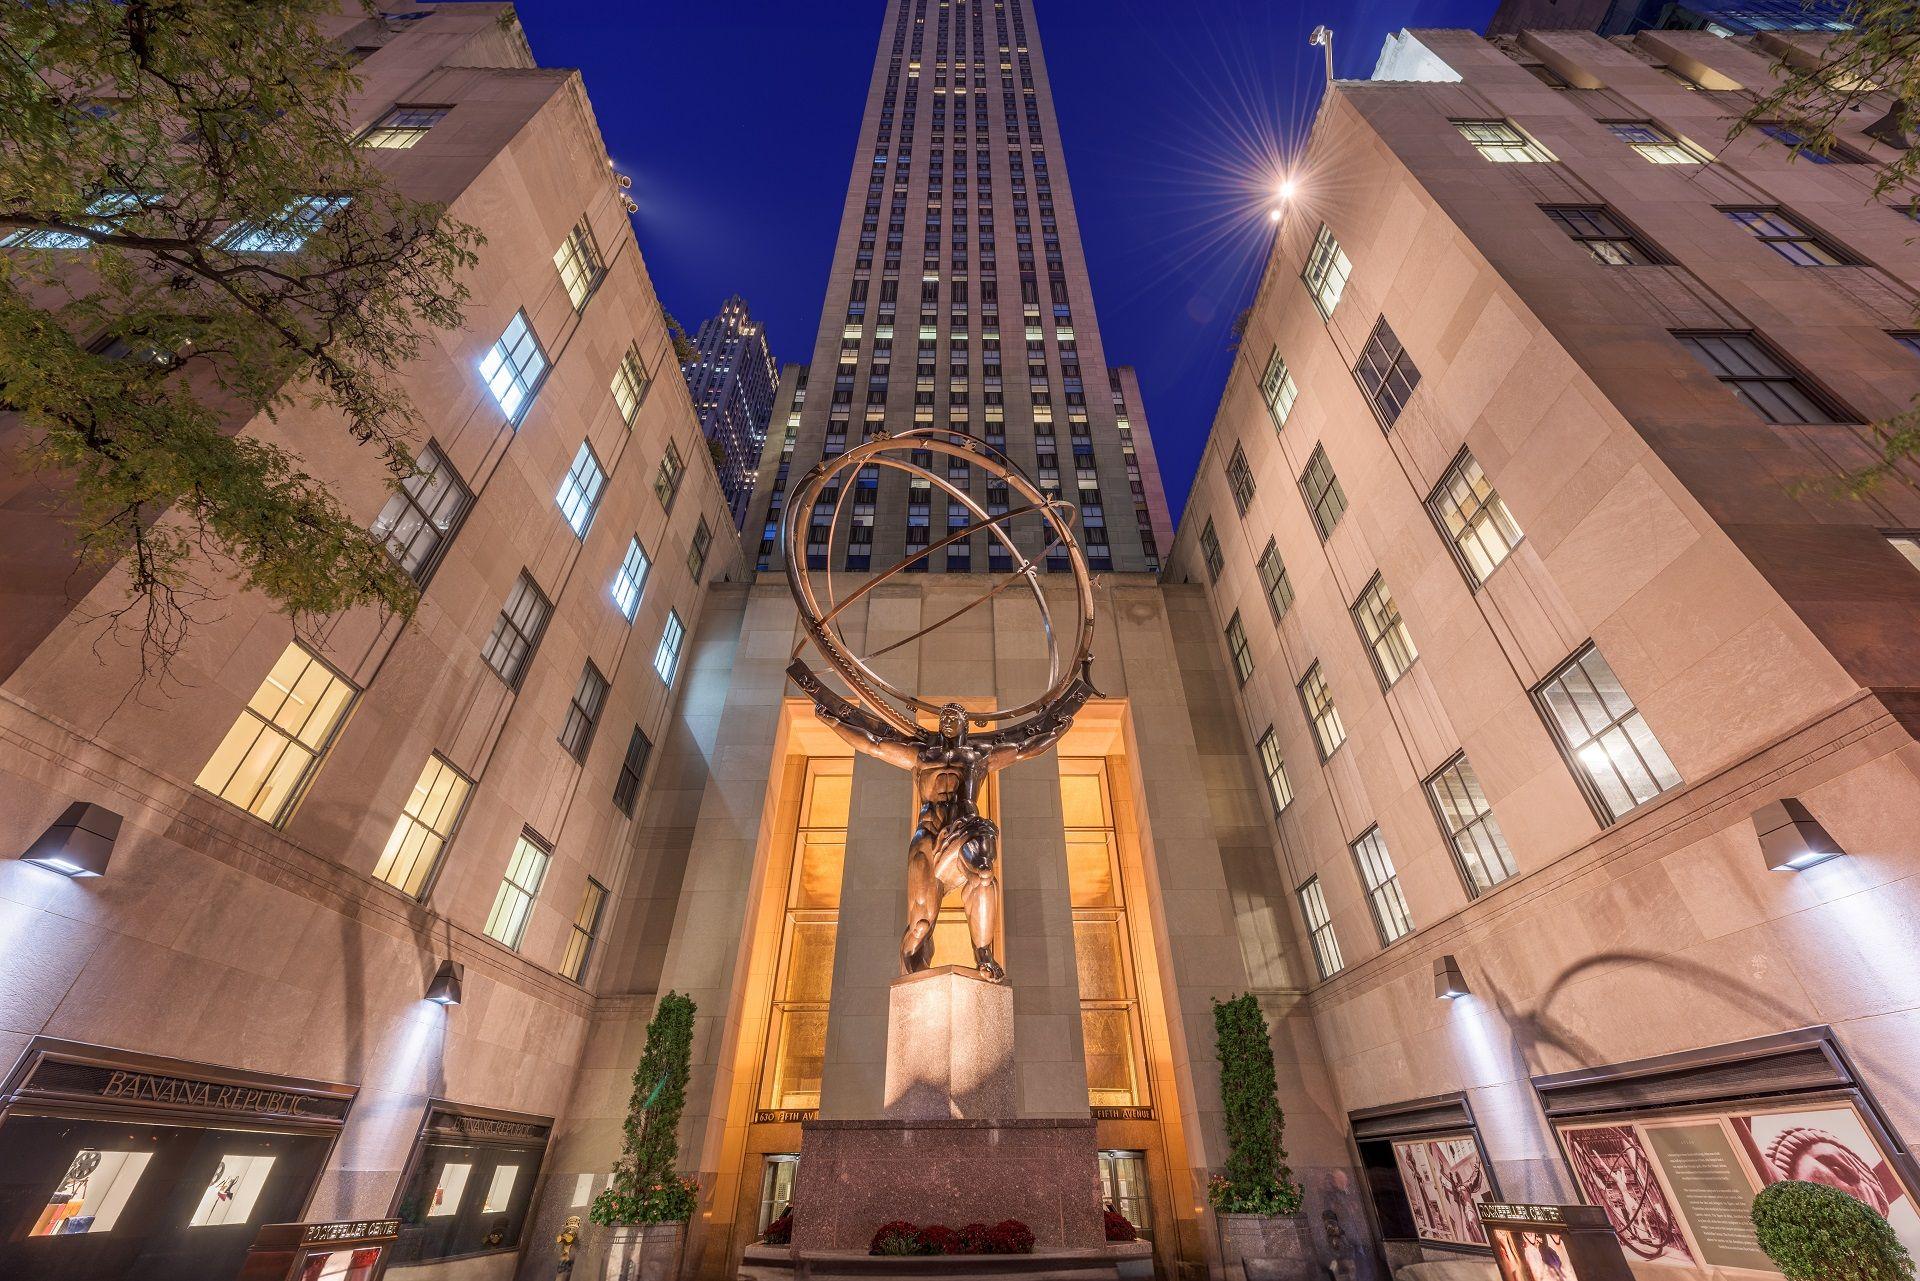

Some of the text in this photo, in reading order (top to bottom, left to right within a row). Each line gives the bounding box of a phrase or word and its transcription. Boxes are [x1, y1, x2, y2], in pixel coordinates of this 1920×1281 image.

[102, 1070, 310, 1115] BANANA REPUBLIC
[759, 1112, 774, 1122] 630
[778, 1112, 799, 1121] FIFTH
[1097, 1109, 1119, 1118] FIFTH
[1122, 1110, 1150, 1119] AVENUE
[1480, 1204, 1531, 1220] ROCKEFELLER
[307, 1221, 398, 1241] ROCKEFELLER CENTER
